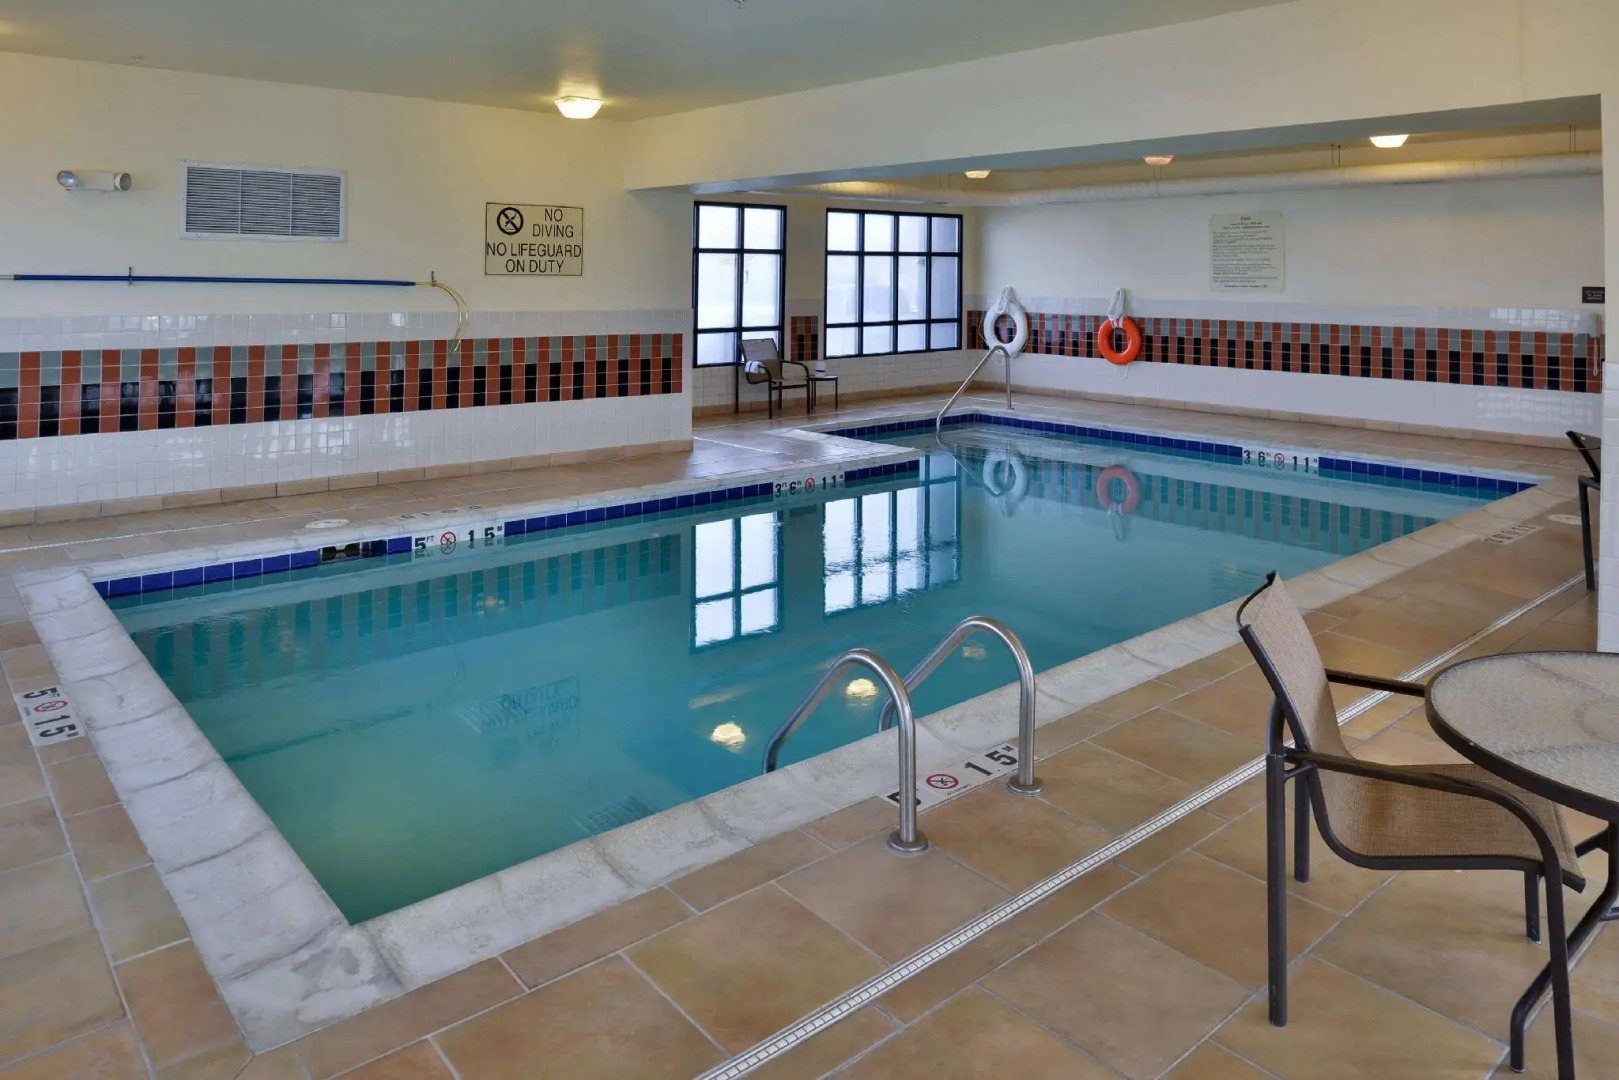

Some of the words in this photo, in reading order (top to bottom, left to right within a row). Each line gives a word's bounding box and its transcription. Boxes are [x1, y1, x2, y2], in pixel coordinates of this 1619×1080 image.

[544, 208, 563, 222] NO
[532, 223, 574, 238] DIVING
[486, 242, 507, 256] NO
[511, 243, 582, 257] LIFEGUARD
[505, 259, 525, 273] ON
[529, 259, 564, 273] DUTY
